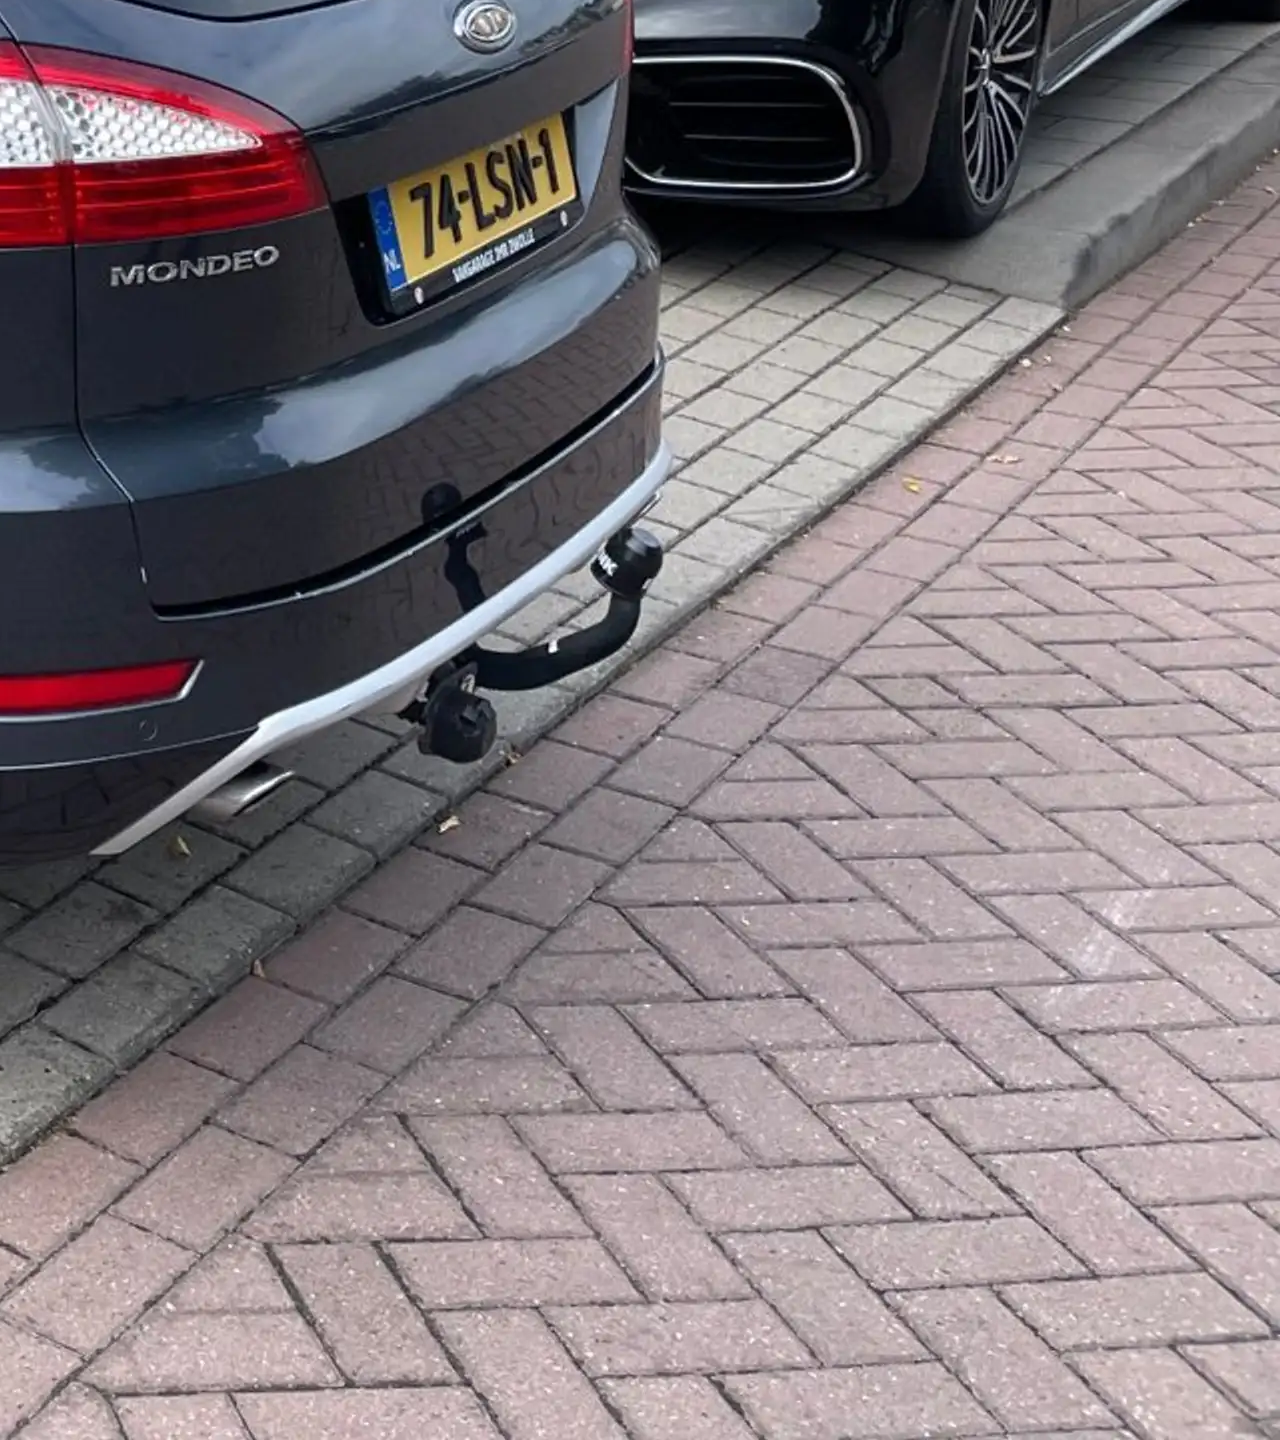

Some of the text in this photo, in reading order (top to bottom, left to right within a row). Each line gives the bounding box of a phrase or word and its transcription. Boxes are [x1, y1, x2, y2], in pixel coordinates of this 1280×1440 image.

[408, 127, 560, 259] 74-LSN-1
[109, 245, 280, 287] MONDEO
[383, 248, 402, 274] NL
